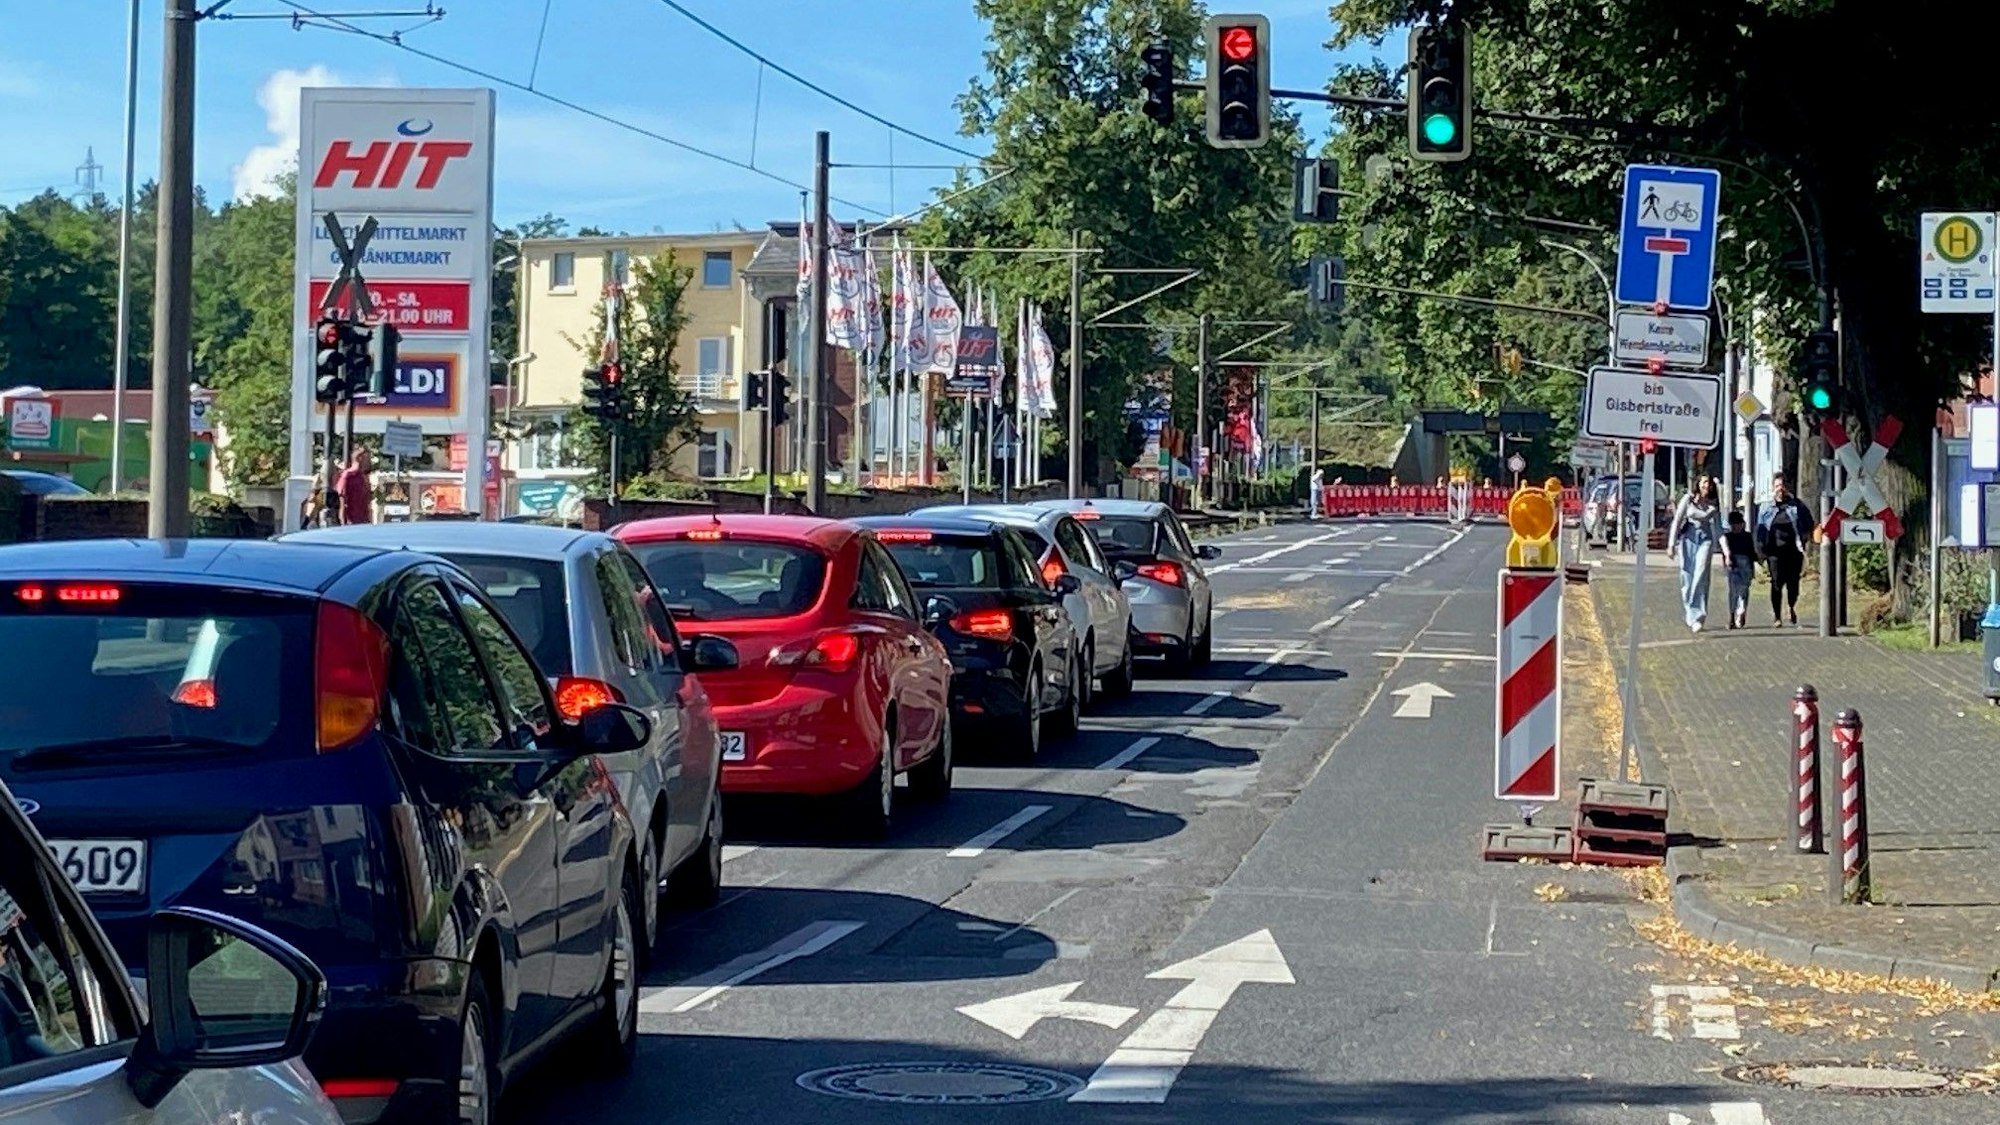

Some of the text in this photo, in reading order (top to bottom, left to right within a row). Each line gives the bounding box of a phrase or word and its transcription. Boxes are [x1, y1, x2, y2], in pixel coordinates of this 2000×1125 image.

[313, 141, 472, 188] HIT
[1948, 226, 1969, 254] H
[423, 308, 454, 325] UHR
[928, 307, 956, 319] HIT
[1648, 321, 1675, 336] Keine
[393, 368, 445, 394] LDI
[1643, 381, 1665, 396] bis
[1605, 397, 1701, 417] Gisbertstraße
[1639, 418, 1664, 433] frei
[48, 846, 138, 886] 609
